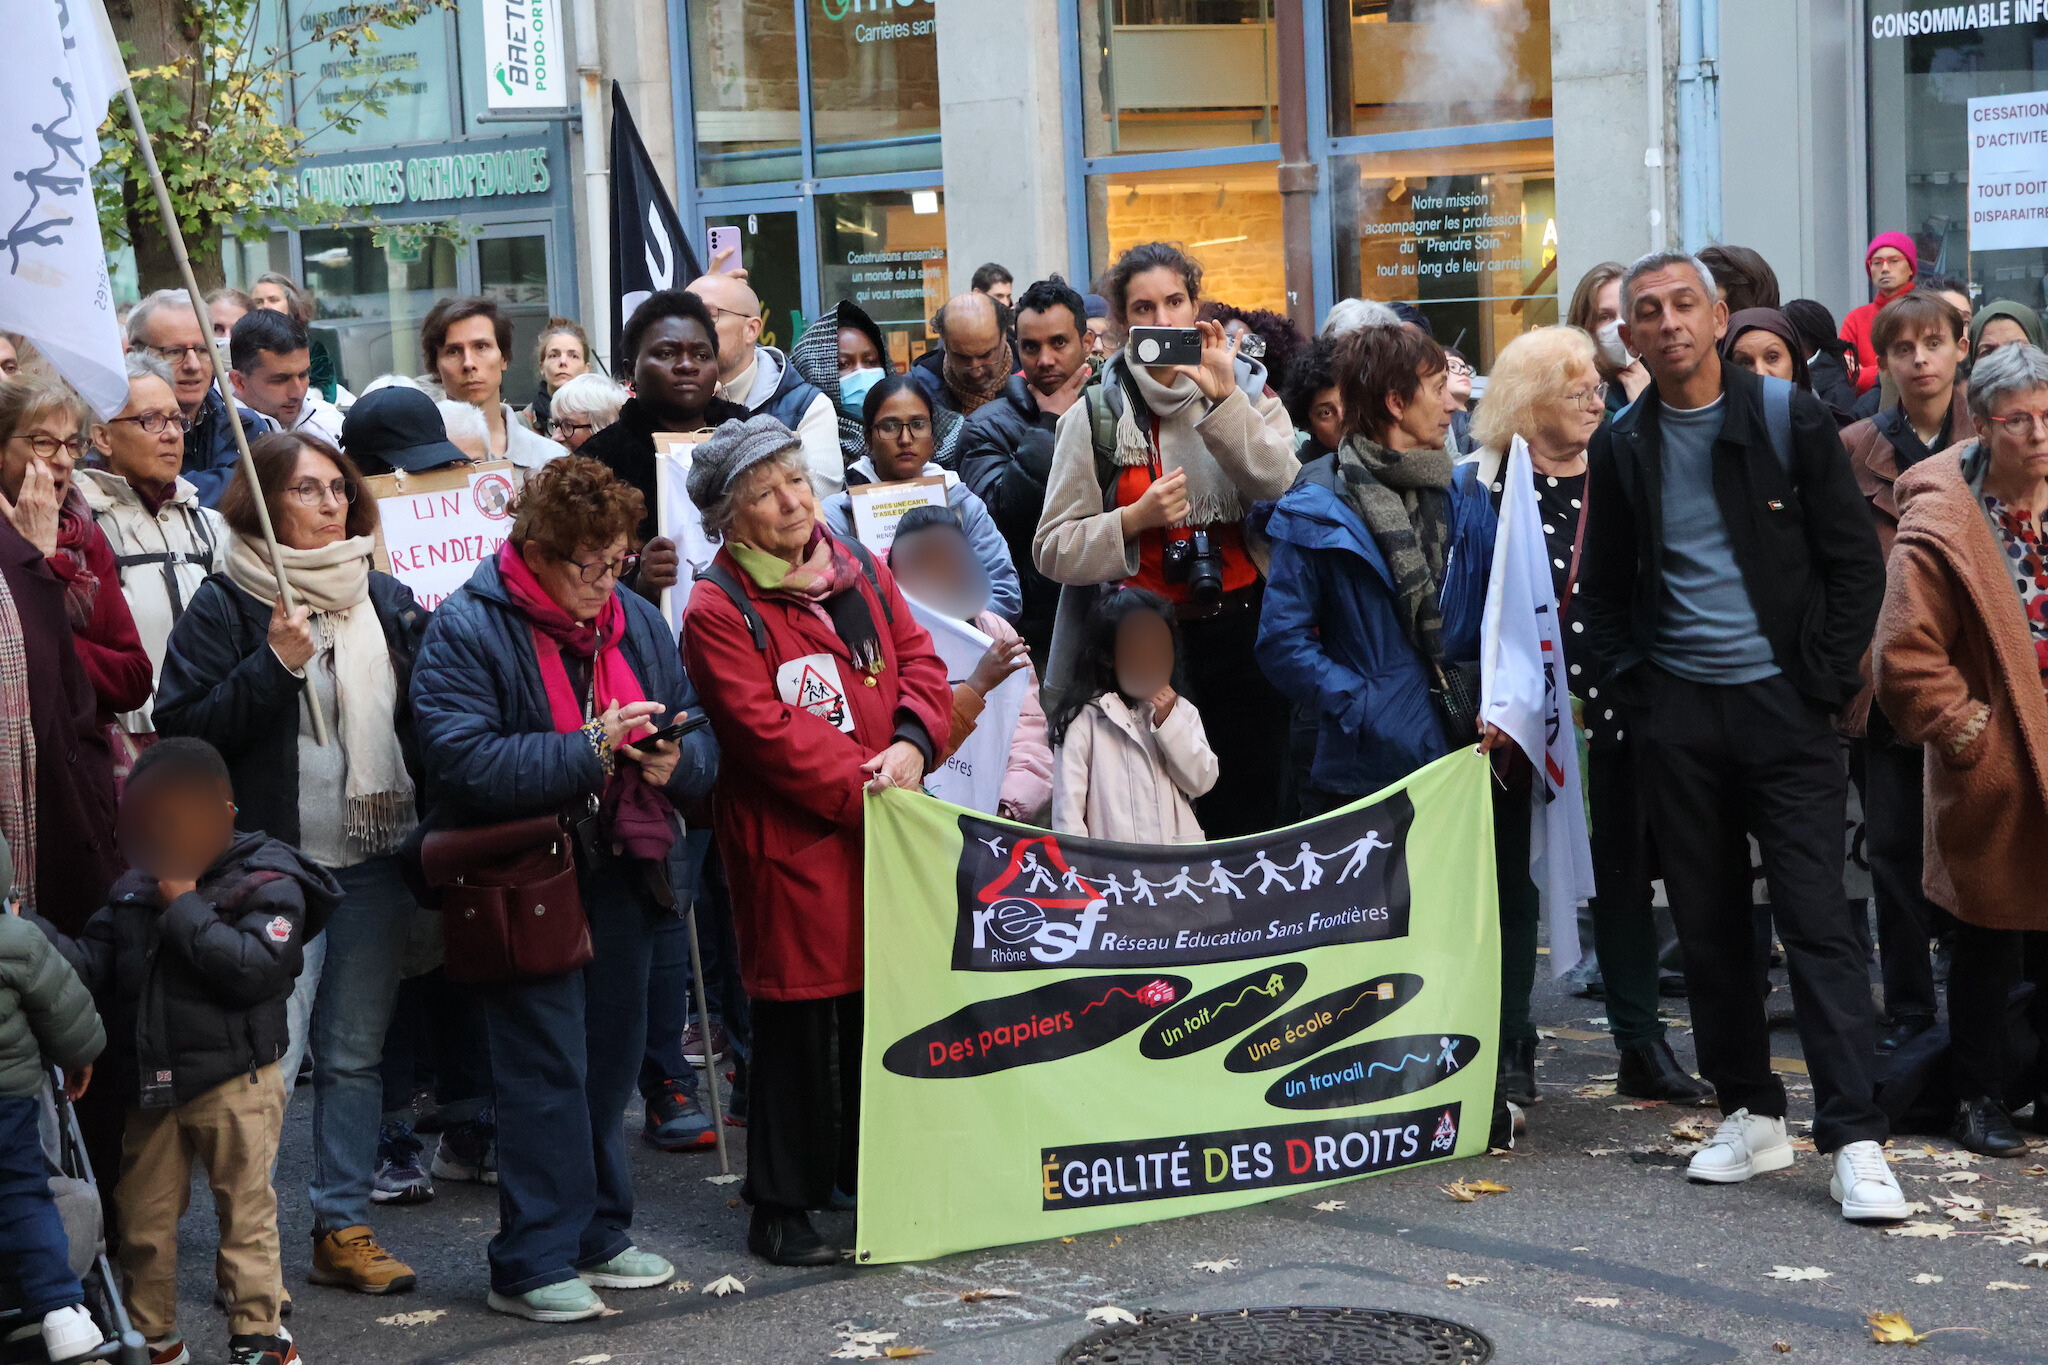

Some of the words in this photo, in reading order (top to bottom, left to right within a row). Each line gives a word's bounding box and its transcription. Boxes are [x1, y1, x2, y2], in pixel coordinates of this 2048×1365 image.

[855, 21, 910, 43] Carrières
[912, 19, 936, 36] san
[1872, 1, 2010, 39] CONSOMMABLE
[1973, 103, 2048, 122] CESSATION
[1976, 129, 2048, 148] D'ACTIVITE
[300, 160, 405, 207] CHAUSSURES
[405, 147, 550, 202] ORTHOPEDIQUES
[1411, 194, 1443, 210] Notre
[1446, 191, 1489, 208] mission
[1977, 183, 2011, 198] TOUT
[2015, 181, 2048, 196] DOIT
[747, 214, 759, 235] 6
[1365, 219, 1441, 236] accompagner
[1444, 214, 1460, 231] les
[1974, 207, 2048, 223] DISPARAITRE
[1399, 239, 1414, 254] du
[1427, 236, 1472, 253] Prendre
[1474, 234, 1500, 250] Soin
[847, 250, 901, 265] Construisons
[903, 247, 944, 261] ensemble
[852, 272, 863, 283] un
[864, 267, 894, 282] monde
[895, 267, 907, 281] de
[907, 267, 917, 280] la
[1376, 263, 1399, 277] tout
[1401, 264, 1415, 276] au
[1417, 260, 1442, 279] long
[1444, 259, 1460, 274] de
[1462, 257, 1484, 273] leur
[856, 287, 870, 304] qui
[871, 289, 892, 300] vous
[412, 492, 460, 520] UN
[893, 500, 905, 508] UNE
[907, 498, 928, 506] CARTE
[972, 897, 1109, 963] resf
[1100, 932, 1170, 951] Réseau
[1174, 927, 1262, 949] Education
[1265, 919, 1304, 940] Sans
[1307, 906, 1389, 933] Frontières
[991, 948, 1027, 963] Rhône
[1160, 1026, 1184, 1047] Un
[1184, 1007, 1211, 1034] toit
[1247, 1037, 1281, 1062] Une
[1284, 1011, 1333, 1043] école
[928, 1036, 975, 1067] Des
[977, 1010, 1075, 1058] papiers
[1285, 1079, 1307, 1098] Un
[1310, 1061, 1365, 1091] travail
[1042, 1141, 1191, 1201] ÉGALITÉ
[1202, 1141, 1274, 1184] DES
[1284, 1124, 1420, 1175] DROITS
